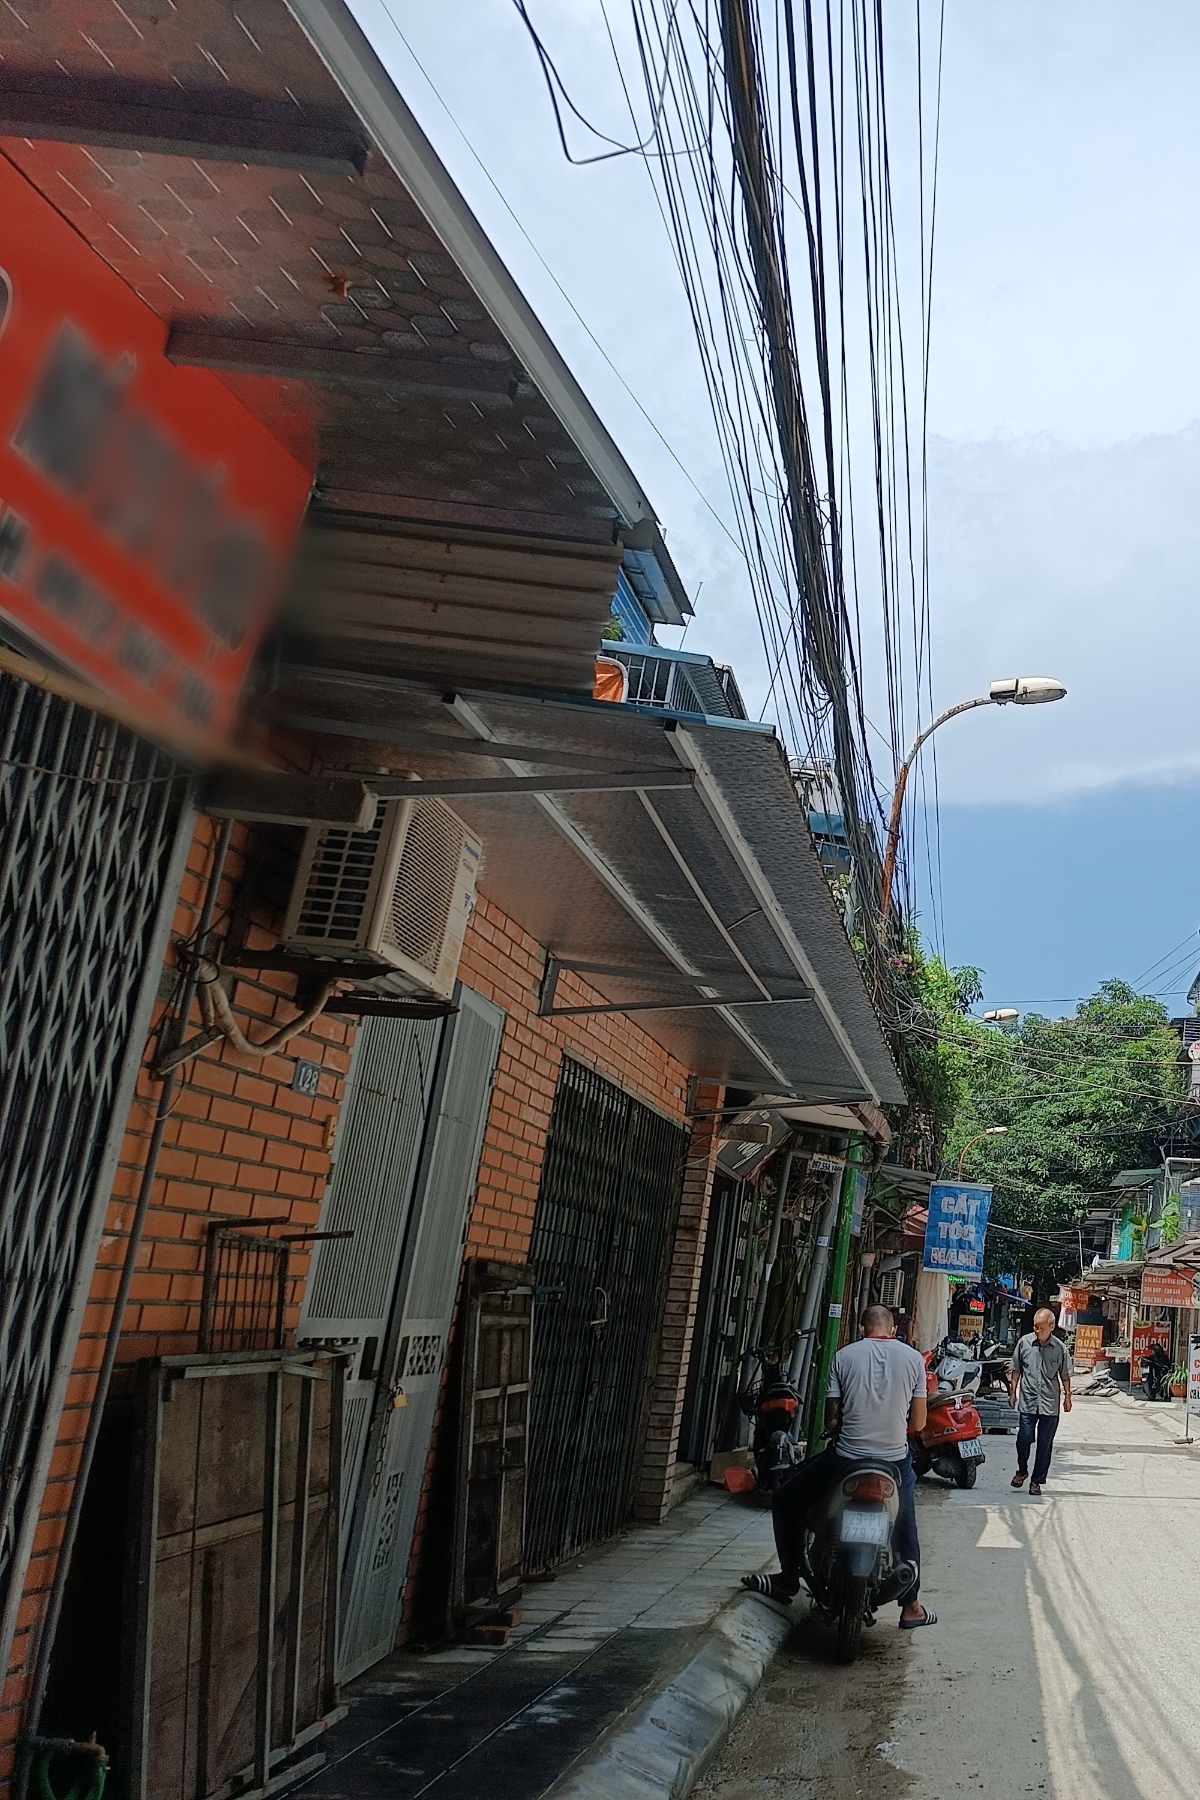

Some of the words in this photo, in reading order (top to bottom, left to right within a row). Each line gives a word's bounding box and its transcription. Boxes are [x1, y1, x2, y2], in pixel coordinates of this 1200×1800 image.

[299, 1066, 318, 1090] 128
[849, 1513, 882, 1526] 29-P1
[844, 1526, 885, 1543] 779.72
